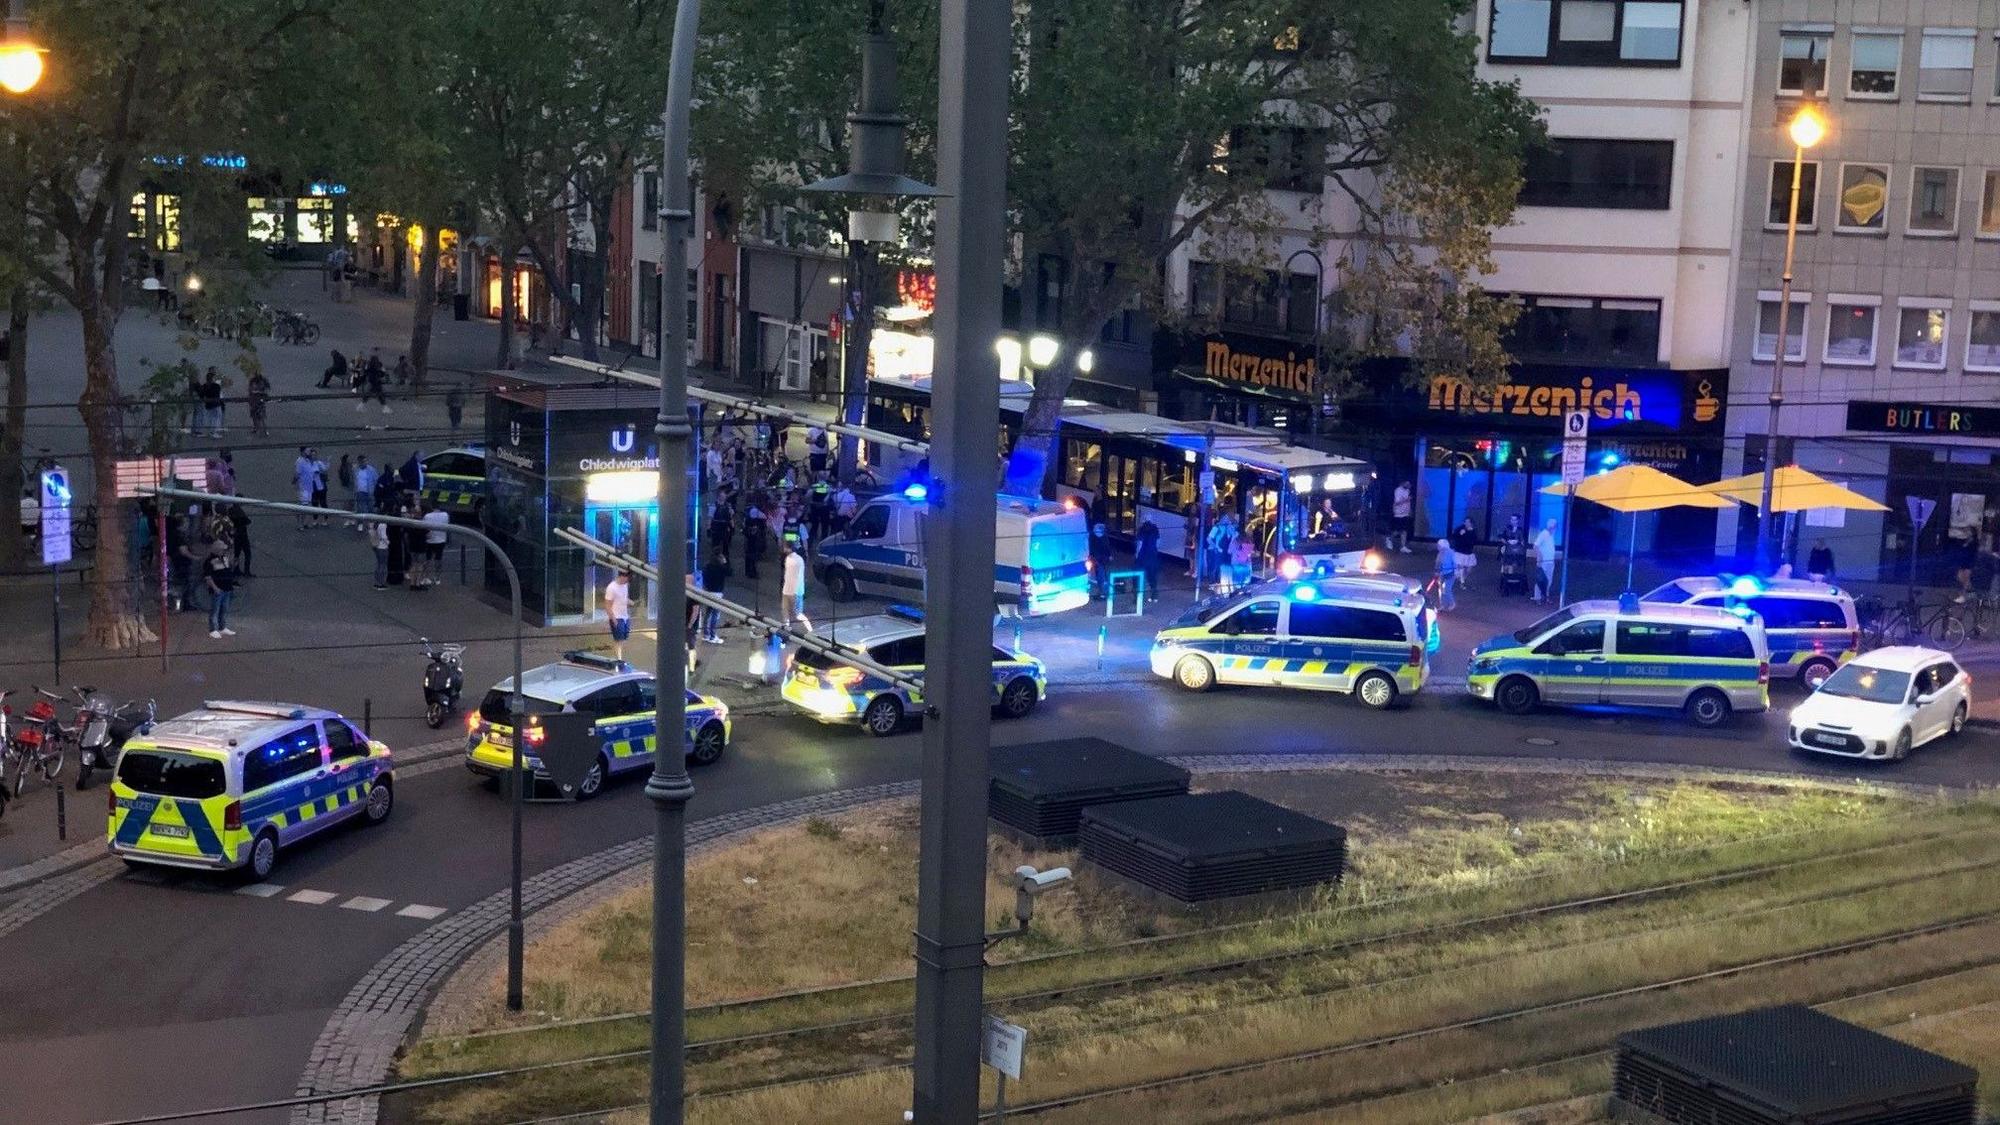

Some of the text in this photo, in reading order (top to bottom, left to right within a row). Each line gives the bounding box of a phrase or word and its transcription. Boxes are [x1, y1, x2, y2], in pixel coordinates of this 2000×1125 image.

[1428, 375, 1642, 421] Merzenich
[1886, 408, 1973, 432] BUTLERS
[611, 430, 634, 453] U
[579, 456, 661, 472] Chlodwigplat
[1234, 643, 1271, 655] POLIZEI
[1625, 664, 1669, 676] POLIZEI
[117, 798, 155, 812] POLIZEI
